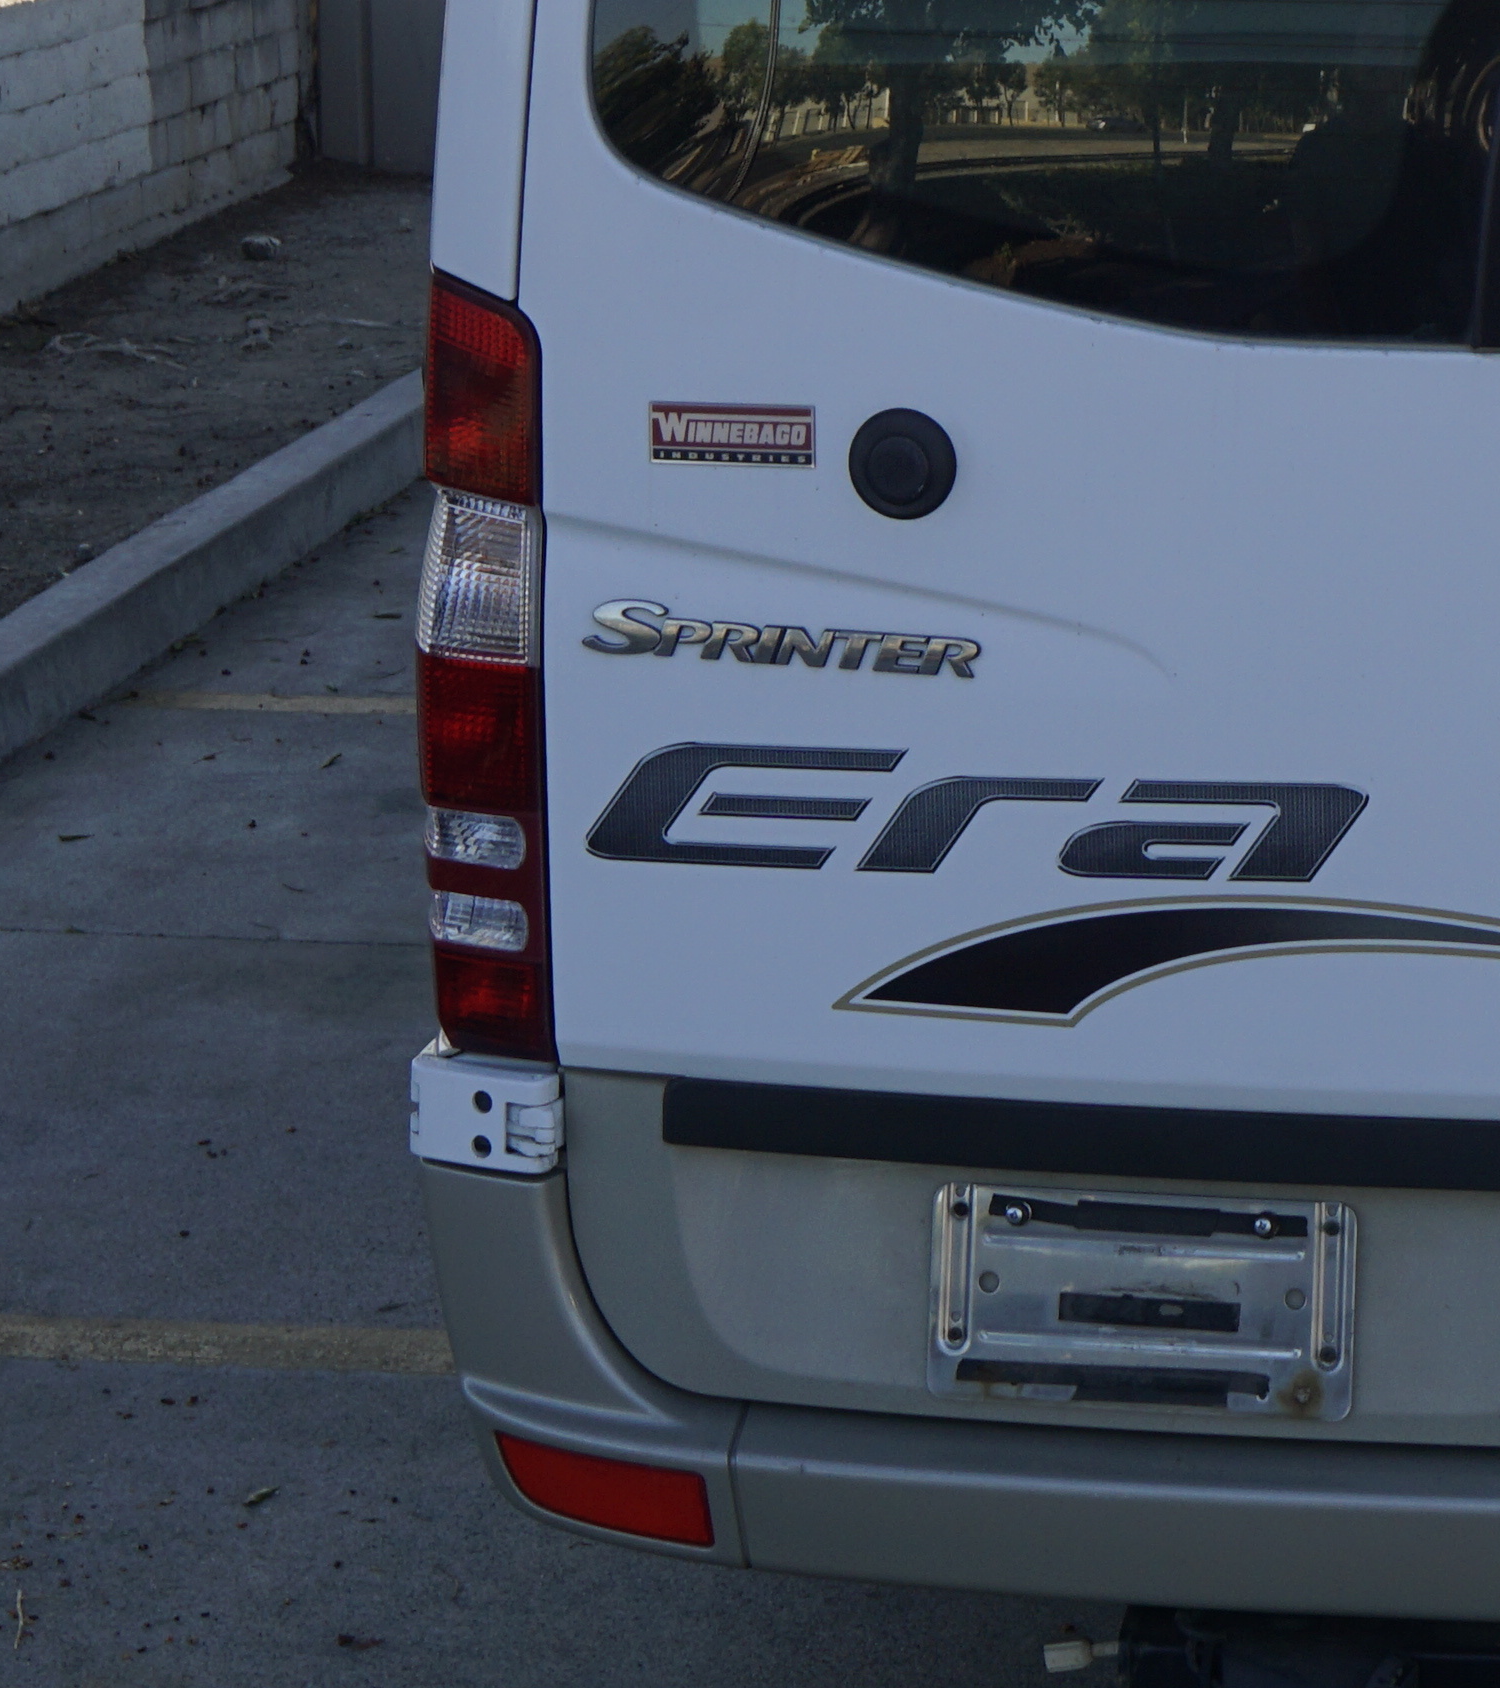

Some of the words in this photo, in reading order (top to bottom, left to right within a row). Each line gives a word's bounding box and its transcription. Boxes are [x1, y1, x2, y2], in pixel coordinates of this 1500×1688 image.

[652, 412, 807, 446] WINNEBAGO
[658, 450, 807, 463] INDUSTRIES
[582, 598, 982, 678] SPRINTER
[585, 741, 1370, 882] Era
